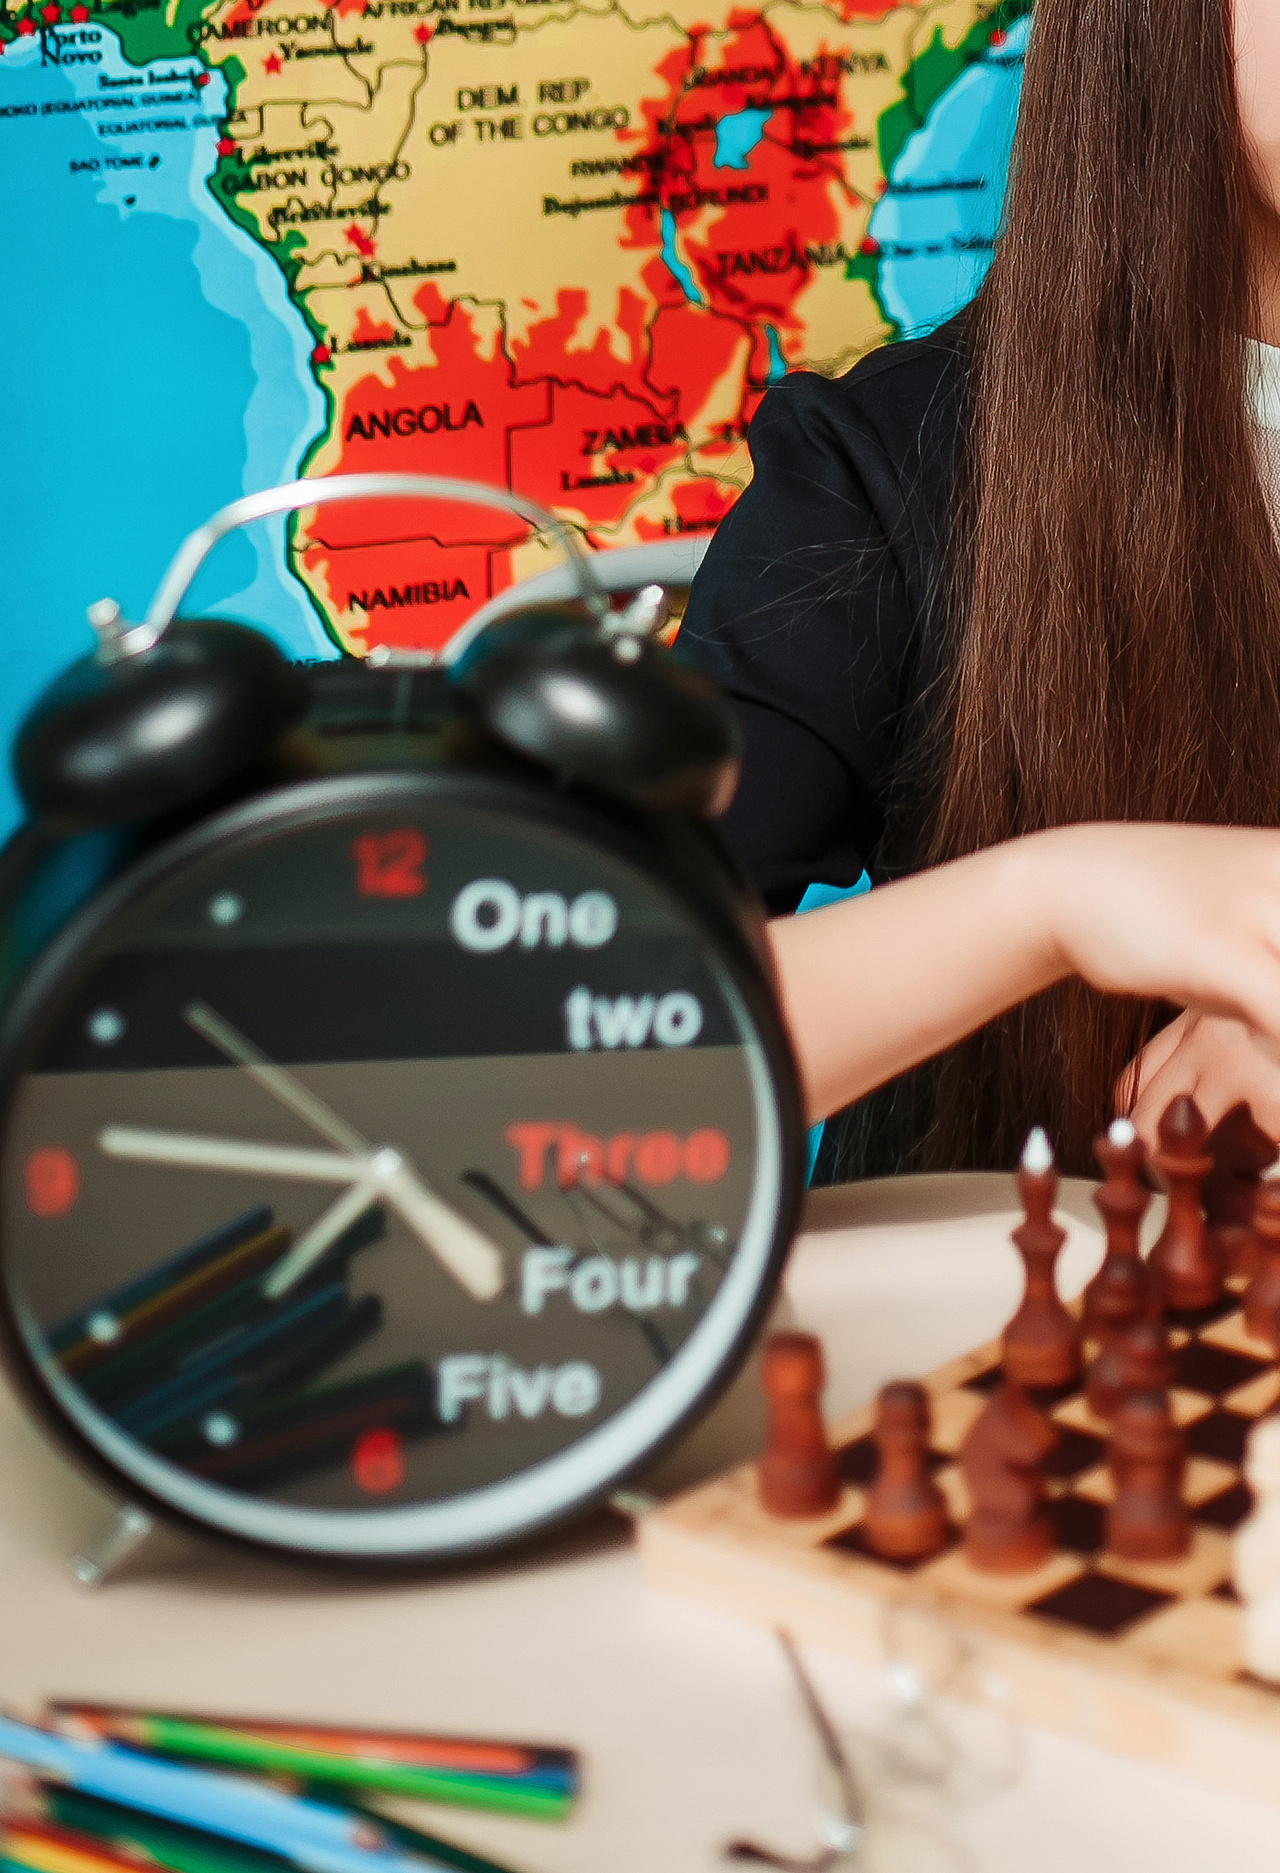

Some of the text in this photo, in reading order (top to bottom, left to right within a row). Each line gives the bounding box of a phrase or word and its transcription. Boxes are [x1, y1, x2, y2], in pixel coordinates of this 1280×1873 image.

[430, 125, 464, 146] OF
[475, 118, 525, 140] THE
[533, 107, 629, 138] CONGO
[457, 79, 591, 110] DEM REP
[321, 162, 411, 188] CONGO
[346, 399, 485, 444] ANGOLA
[347, 577, 471, 614] NAMIBIA
[352, 828, 430, 898] 12
[451, 878, 618, 954] One
[566, 986, 704, 1052] two
[505, 1120, 731, 1191] Three
[520, 1245, 699, 1315] Four
[437, 1353, 602, 1424] Five
[351, 1426, 406, 1494] 6
